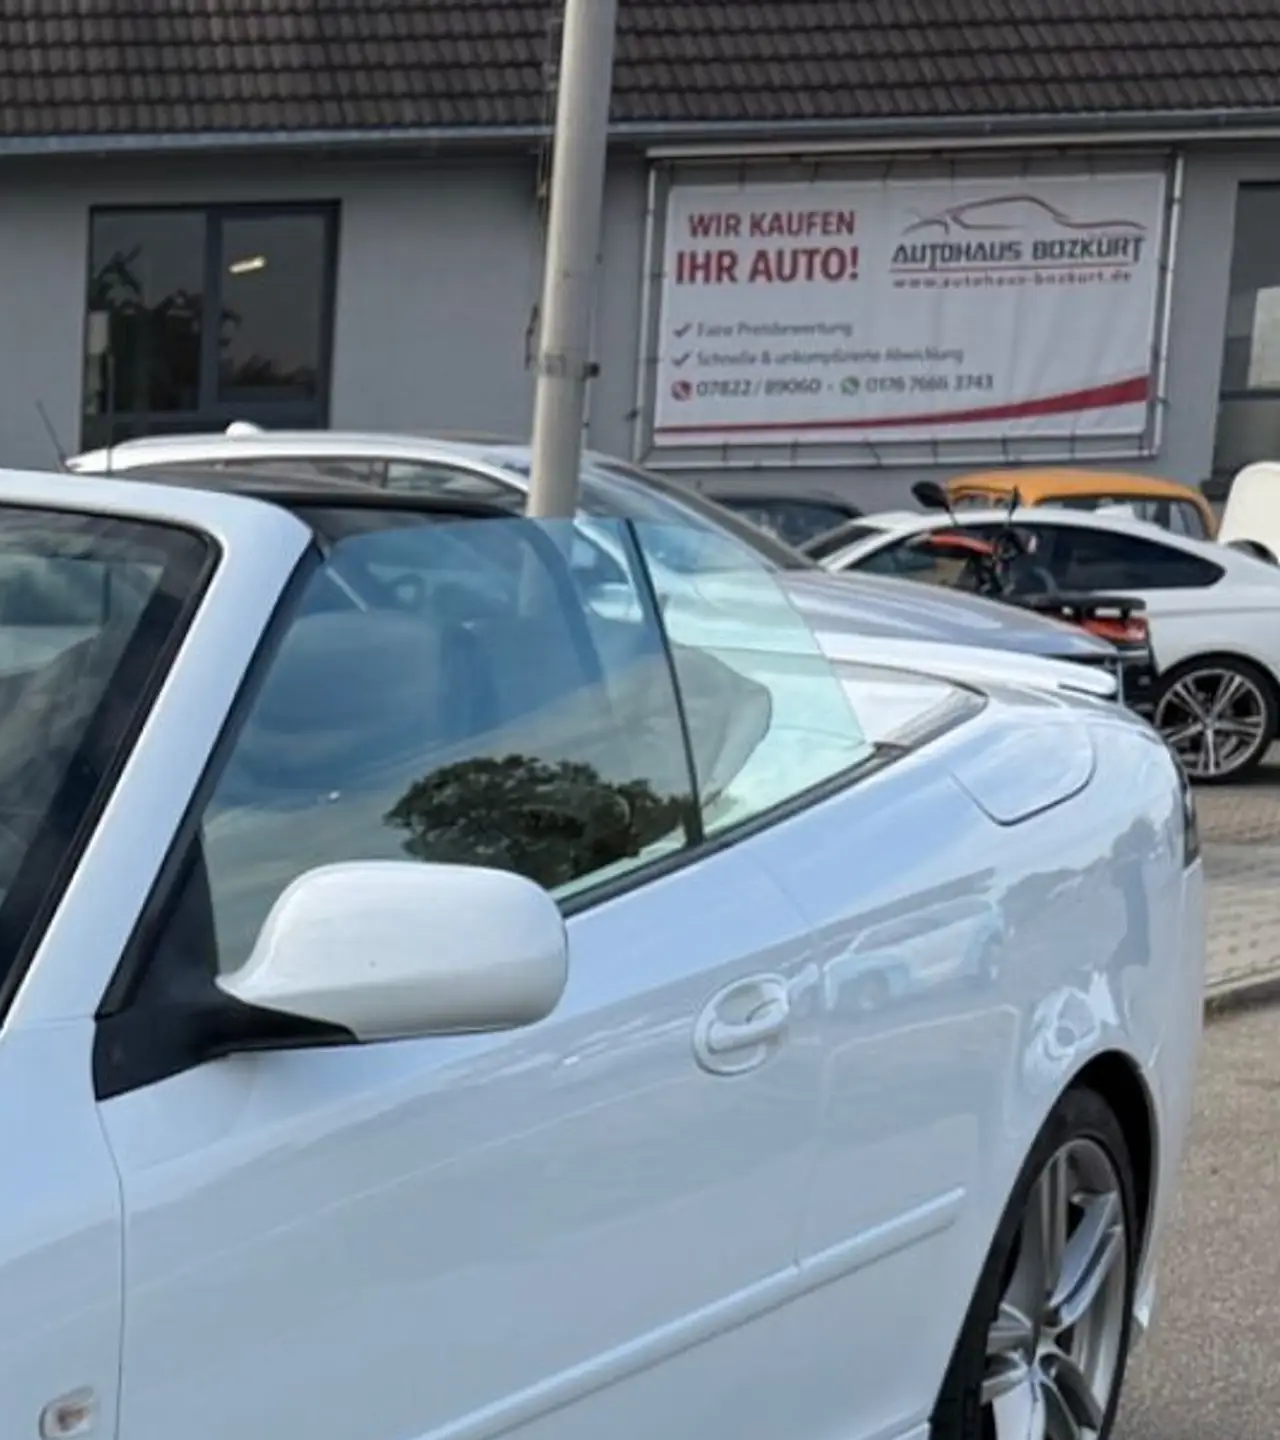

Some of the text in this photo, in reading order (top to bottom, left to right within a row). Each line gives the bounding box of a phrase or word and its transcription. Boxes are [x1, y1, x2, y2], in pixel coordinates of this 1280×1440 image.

[688, 209, 855, 237] WIR KAUFEN
[675, 246, 859, 284] IHR AUTO!
[891, 233, 1145, 271] AUTOHAUS BOZKURT
